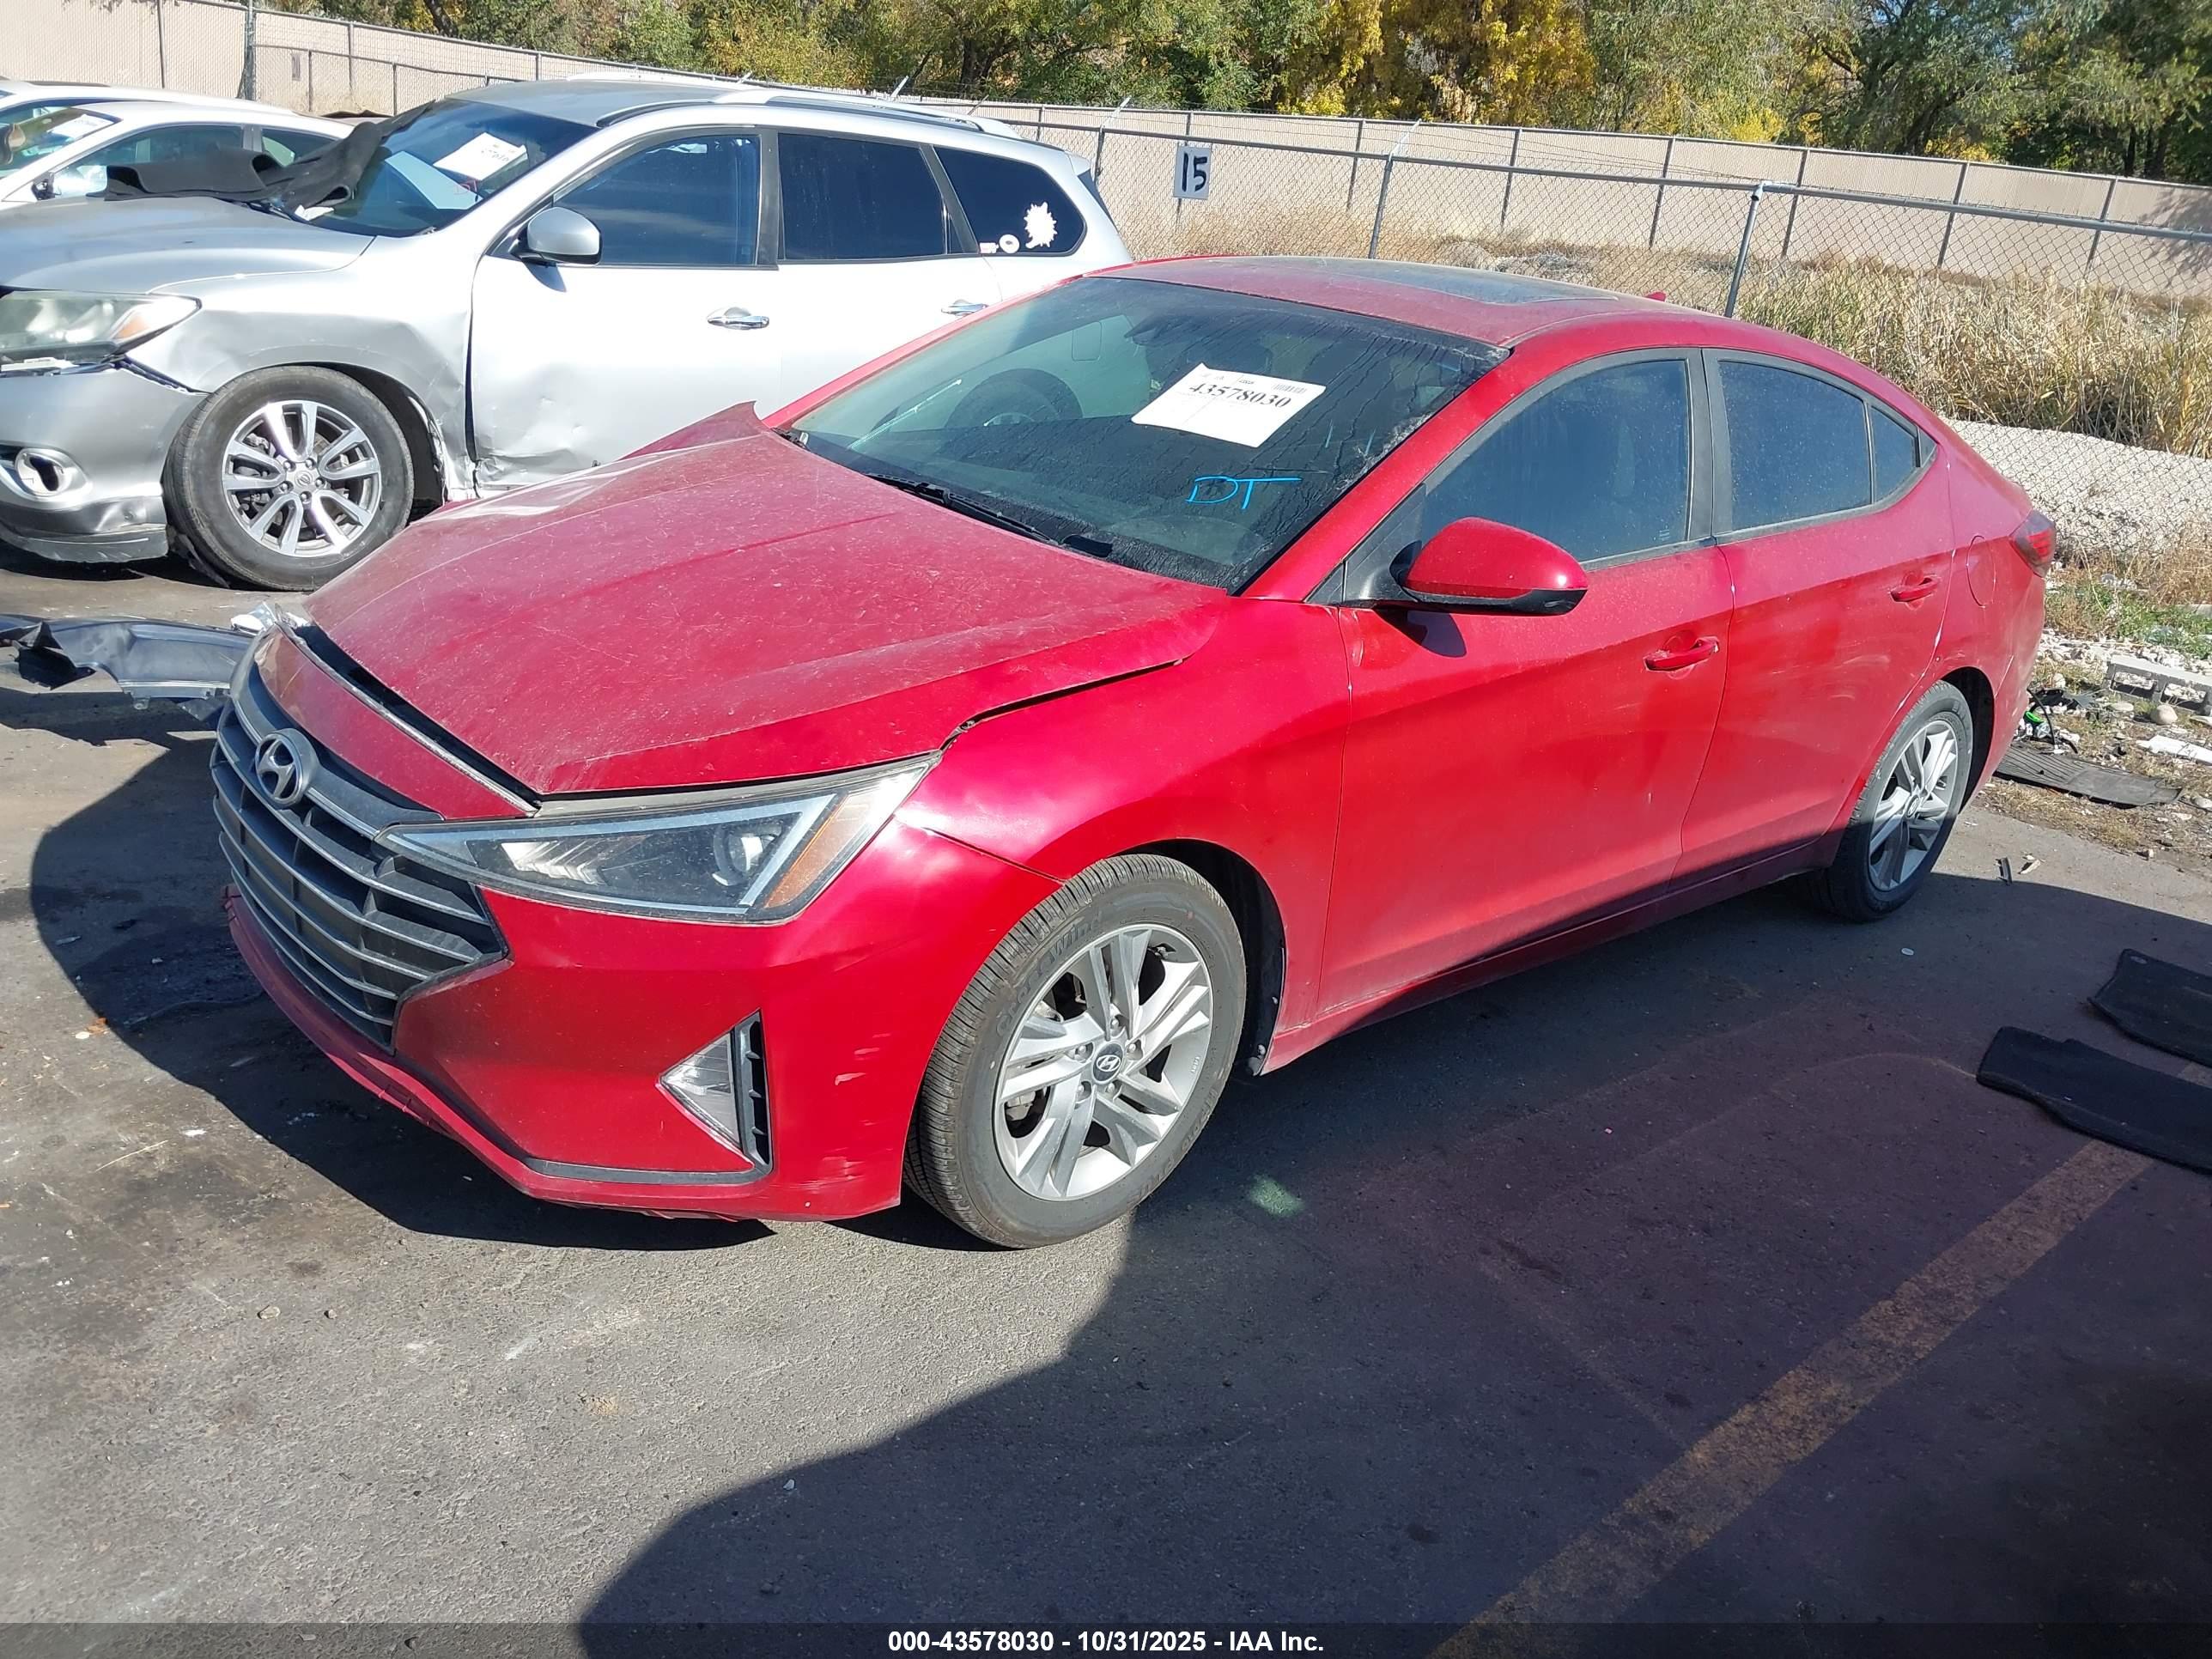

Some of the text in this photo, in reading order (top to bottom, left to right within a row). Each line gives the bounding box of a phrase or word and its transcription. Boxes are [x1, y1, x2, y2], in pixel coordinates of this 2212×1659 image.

[1182, 150, 1208, 192] 15
[1189, 383, 1291, 408] 43578030
[1185, 475, 1303, 509] DT
